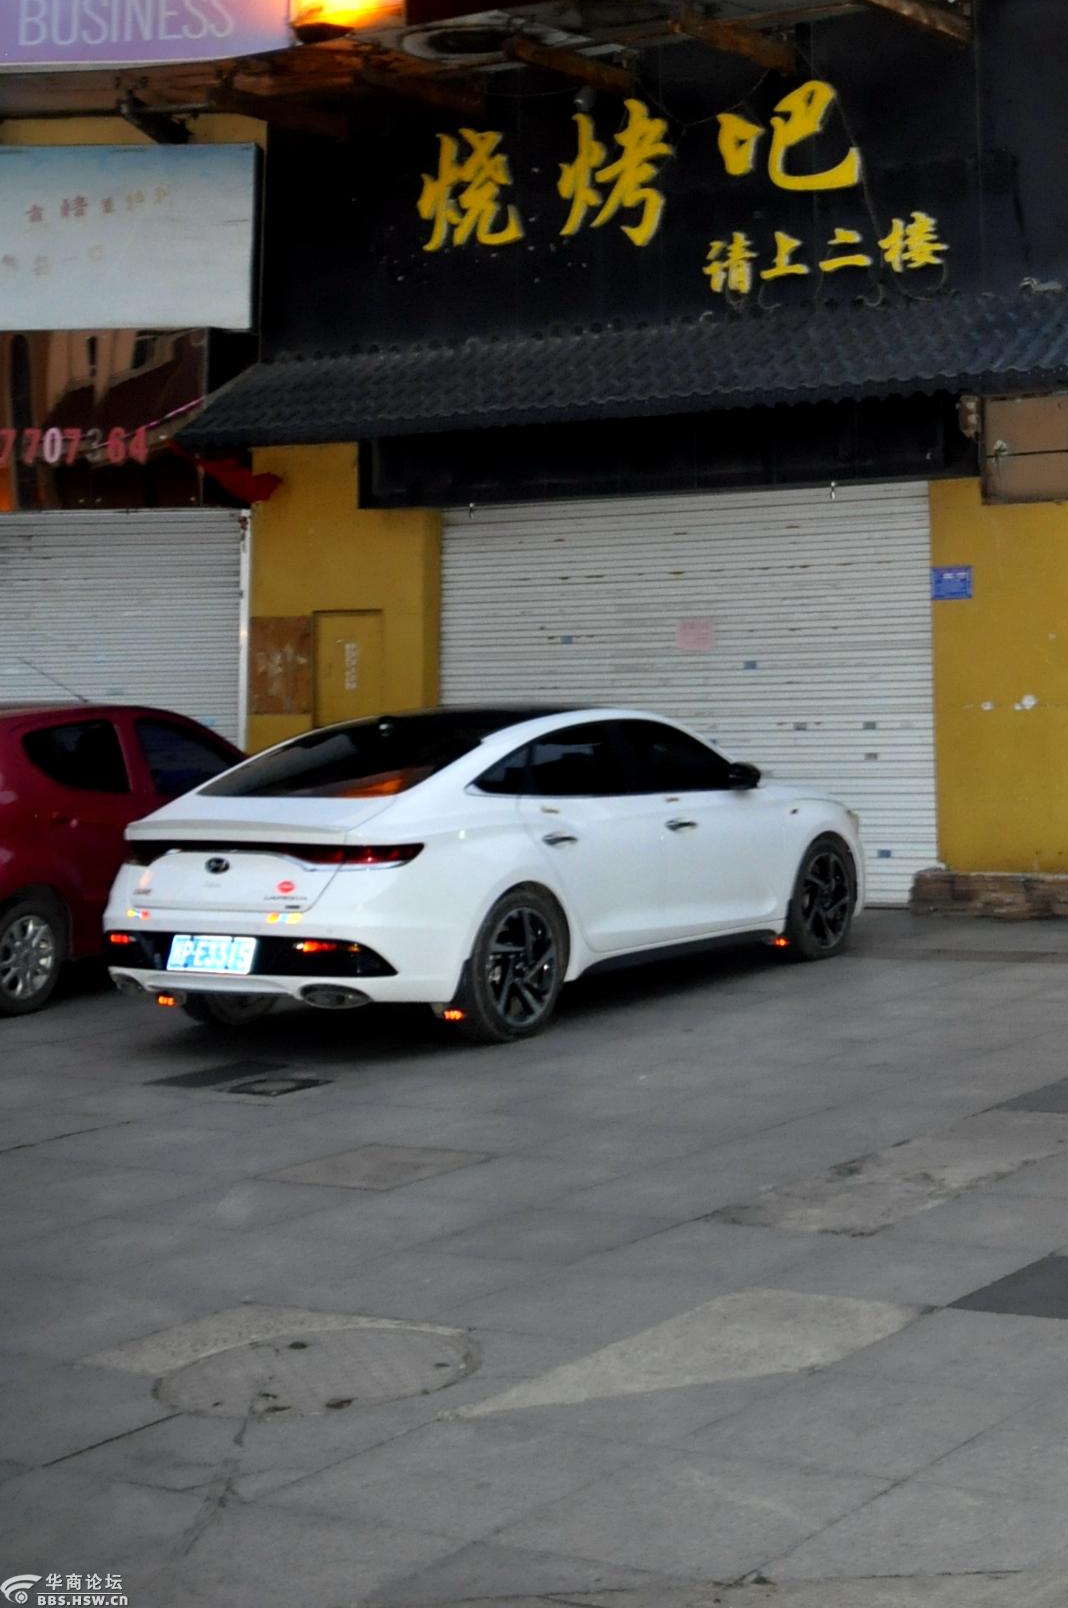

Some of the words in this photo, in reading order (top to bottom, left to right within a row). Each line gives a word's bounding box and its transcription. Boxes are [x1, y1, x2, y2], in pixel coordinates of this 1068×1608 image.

[416, 79, 863, 252] 烧烤吧
[704, 210, 949, 294] 请上二楼
